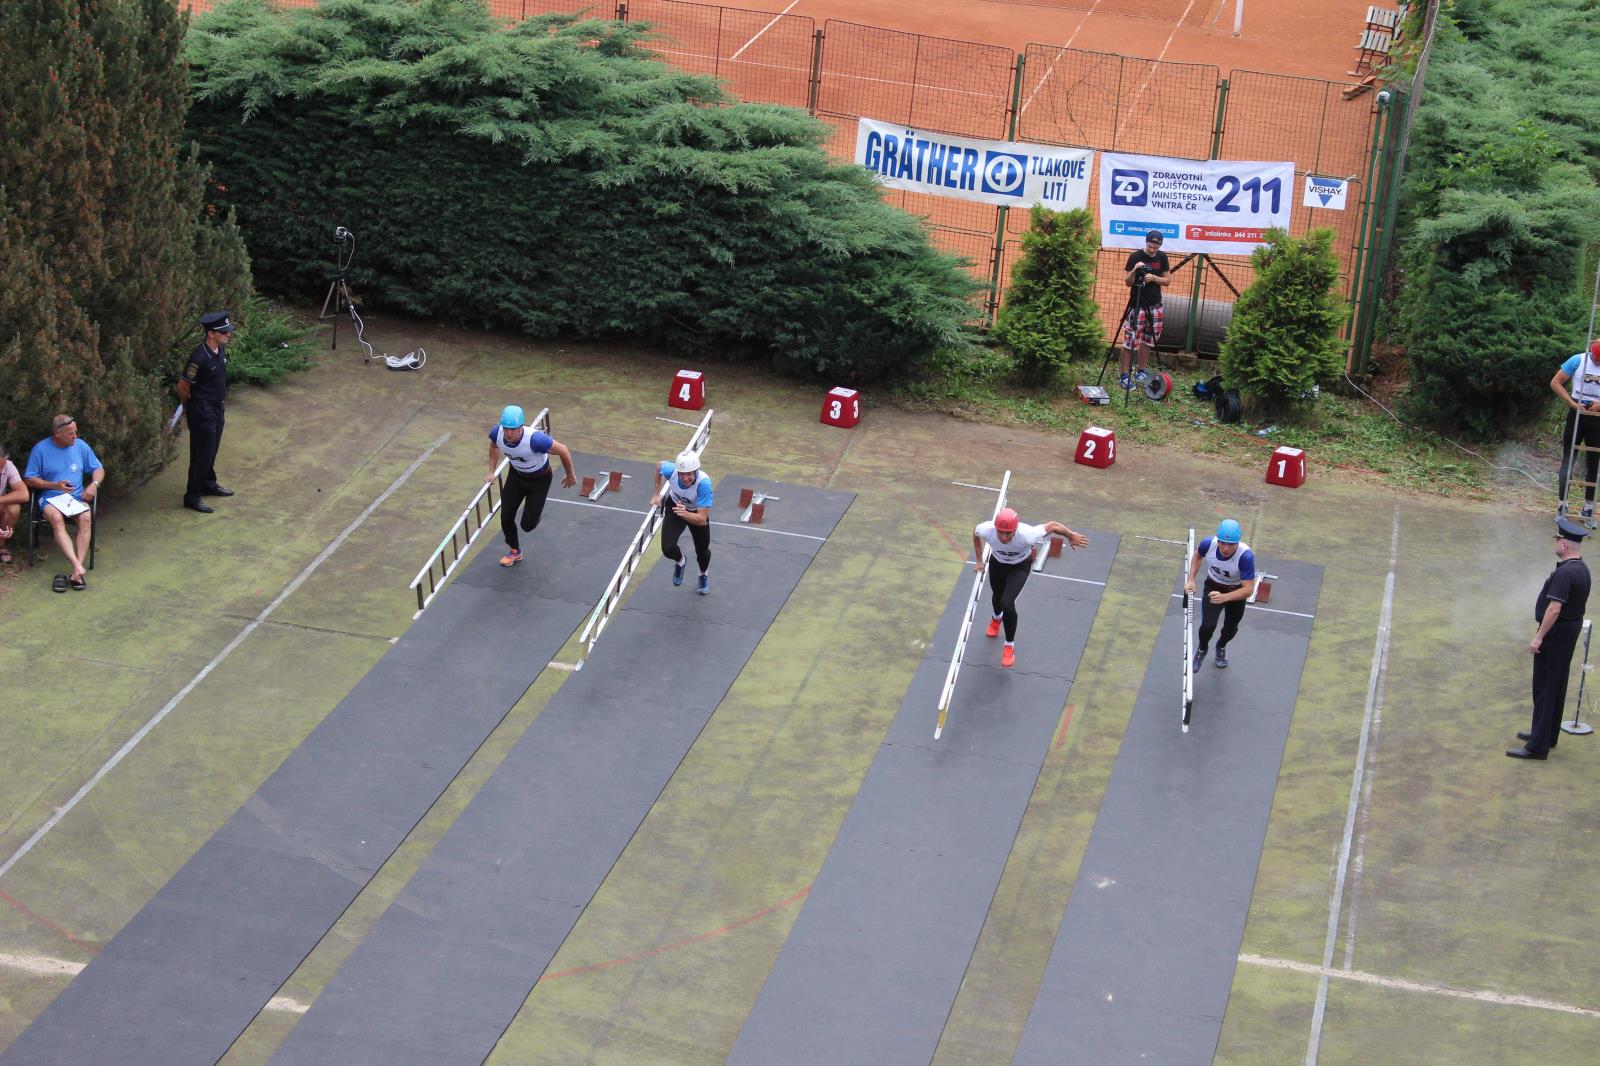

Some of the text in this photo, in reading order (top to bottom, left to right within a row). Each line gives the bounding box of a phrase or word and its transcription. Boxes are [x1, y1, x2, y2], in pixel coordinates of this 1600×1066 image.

[864, 130, 979, 191] GRÄTHER
[1032, 155, 1086, 180] TLAKOVÉ
[1152, 171, 1204, 182] ZDRAVOTNÍ
[1152, 180, 1208, 192] POJIŠŤOVNA
[1042, 179, 1068, 202] LITÍ
[1151, 191, 1214, 202] MINISTERSTVA
[1214, 174, 1282, 215] 211
[1308, 185, 1342, 195] VISHAY
[1151, 200, 1197, 211] VNITRA ČR
[678, 383, 691, 402] 4
[829, 400, 842, 420] 3
[1083, 439, 1097, 460] 2
[1108, 439, 1114, 460] 2
[1277, 459, 1287, 479] 1
[1299, 459, 1304, 478] 1
